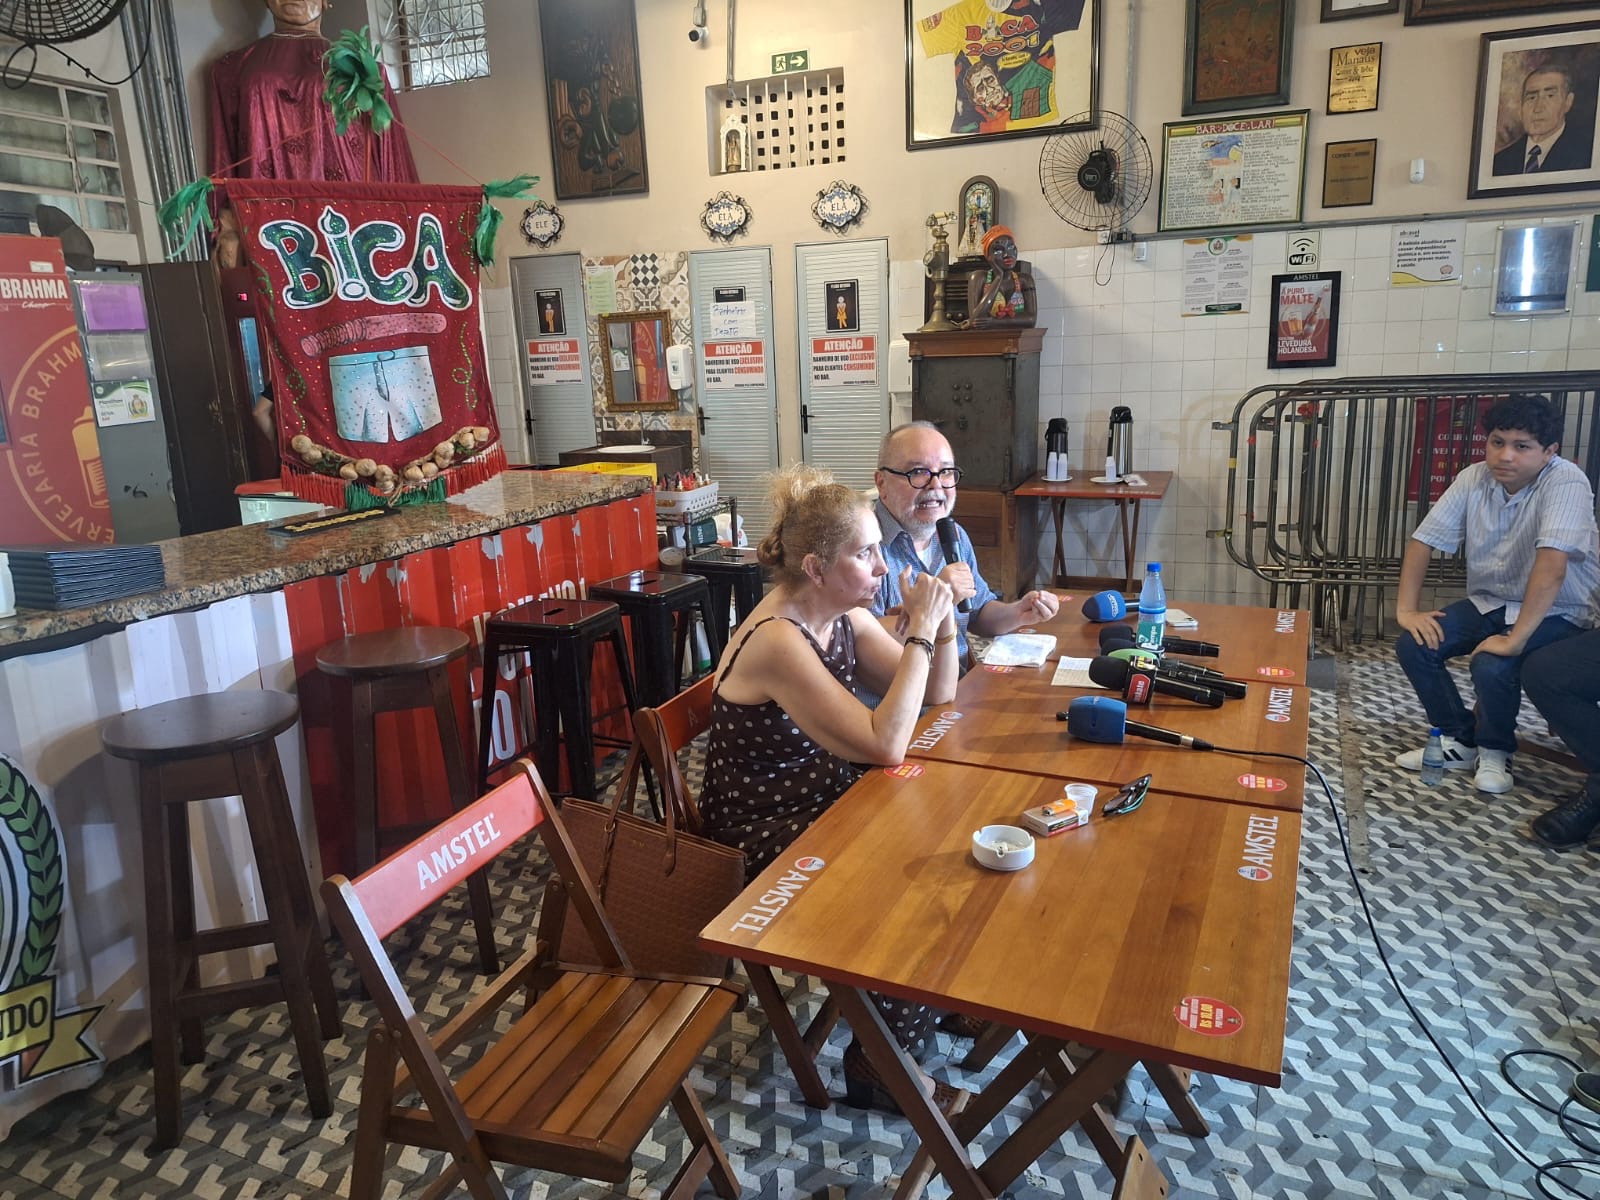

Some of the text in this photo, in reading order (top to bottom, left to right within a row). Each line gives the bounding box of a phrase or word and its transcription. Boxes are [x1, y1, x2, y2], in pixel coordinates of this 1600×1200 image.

[965, 30, 1040, 56] 2001
[1355, 46, 1376, 56] veja
[1336, 51, 1375, 67] Manaus
[830, 203, 848, 212] ELA
[718, 212, 734, 222] ELA
[535, 220, 549, 229] ELE
[1293, 273, 1320, 281] AMSTEL
[0, 278, 69, 300] BRAHMA
[1280, 293, 1315, 305] MALTE
[537, 342, 570, 354] ATENÇÃO
[715, 342, 753, 356] ATENÇÃO
[823, 338, 864, 352] ATENÇÃO
[1277, 346, 1317, 354] HOLANDESA
[1278, 339, 1312, 348] LEVEDURA
[1267, 686, 1294, 716] AMSTEL
[908, 718, 956, 752] AMSTEL
[1242, 814, 1279, 868] AMSTEL
[416, 812, 501, 890] AMSTEL
[728, 869, 811, 934] AMSTEL
